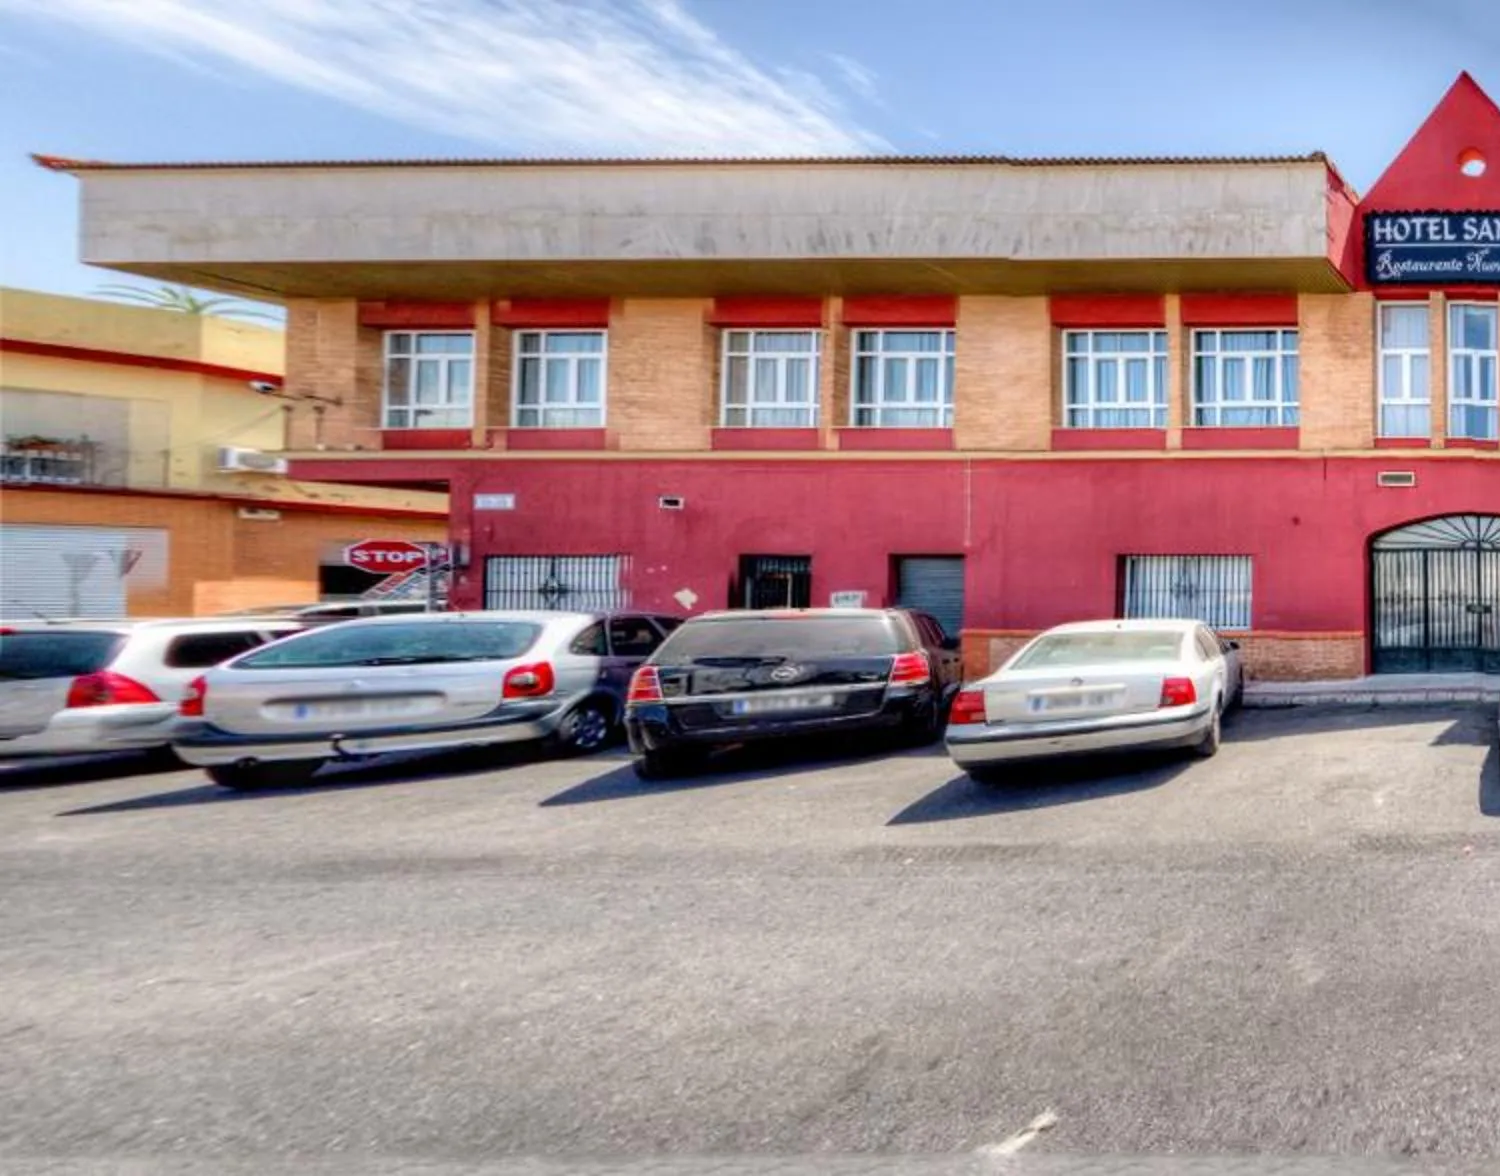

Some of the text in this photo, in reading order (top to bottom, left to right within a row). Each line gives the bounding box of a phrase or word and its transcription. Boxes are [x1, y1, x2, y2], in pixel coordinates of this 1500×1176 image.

[1374, 217, 1457, 242] HOTEL
[1375, 249, 1463, 279] Restaurante
[351, 549, 423, 563] STOP
